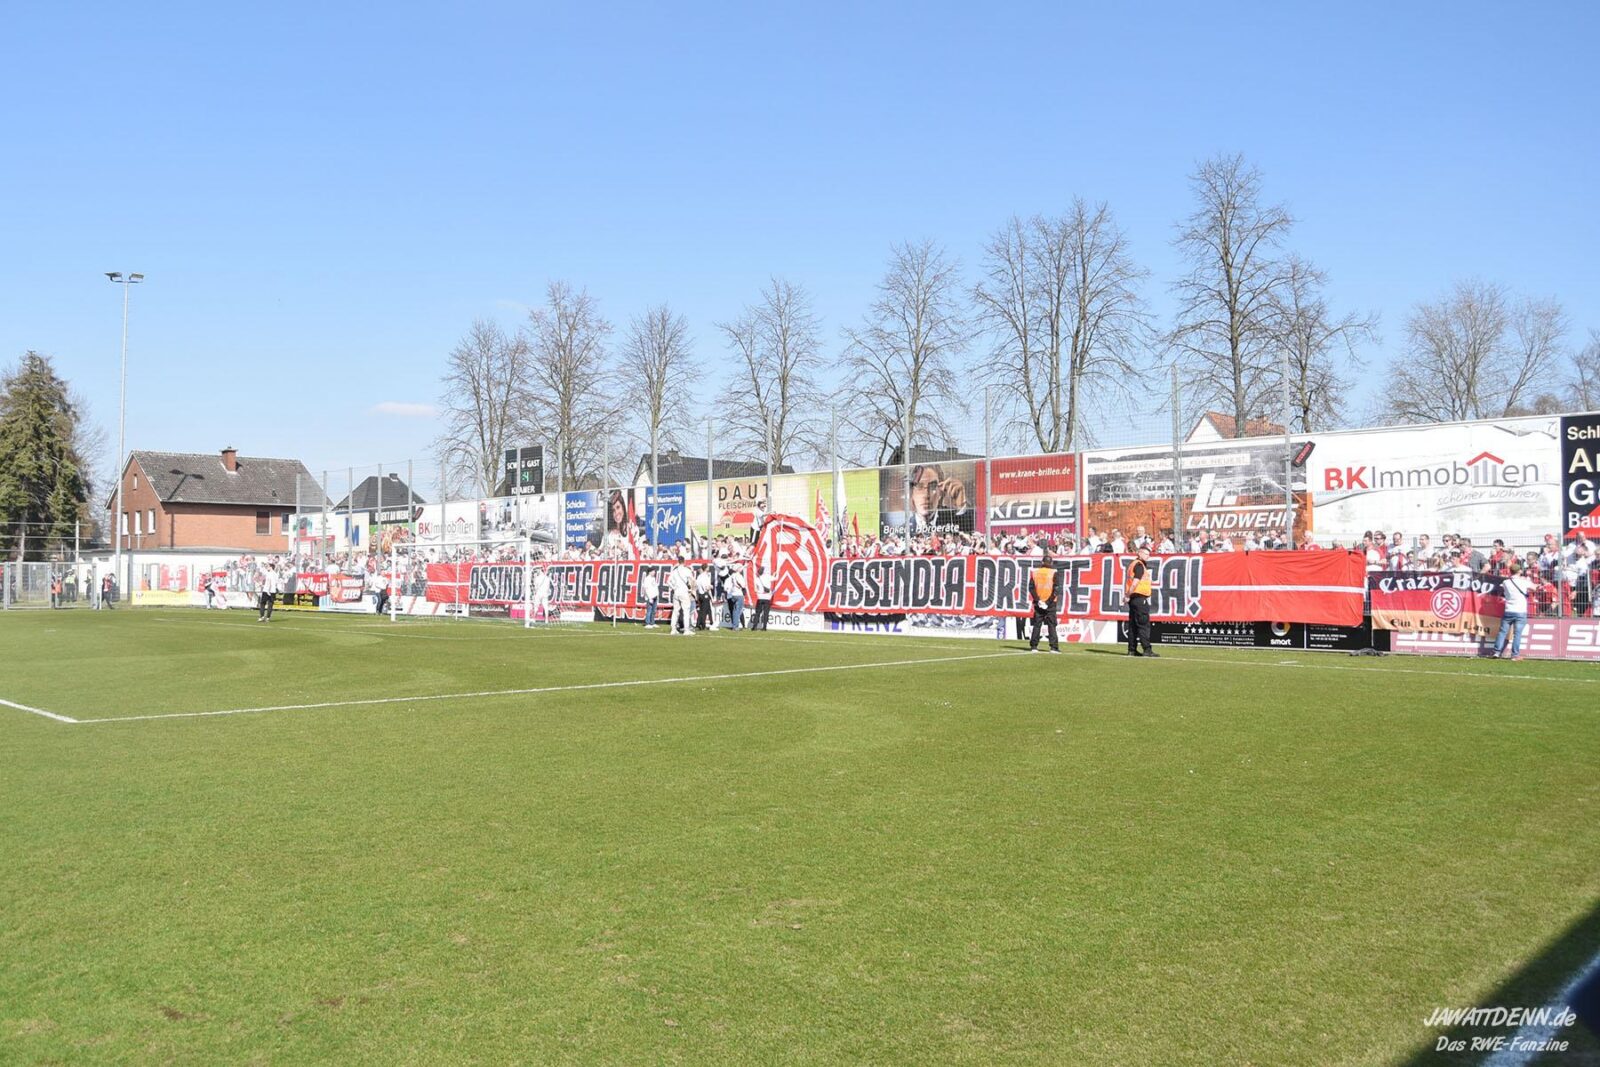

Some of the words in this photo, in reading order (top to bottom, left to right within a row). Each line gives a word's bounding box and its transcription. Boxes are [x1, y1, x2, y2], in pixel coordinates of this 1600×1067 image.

[999, 467, 1071, 479] www.krane-brillen.de
[1324, 460, 1539, 491] BKImmobilien
[1569, 479, 1600, 505] G
[990, 498, 1075, 519] krane
[1186, 511, 1296, 530] LANDWEHR
[597, 564, 634, 605] AUF
[829, 557, 966, 612] ASSINDIA
[1379, 573, 1500, 596] Crazy-Boy
[1270, 638, 1292, 646] smart
